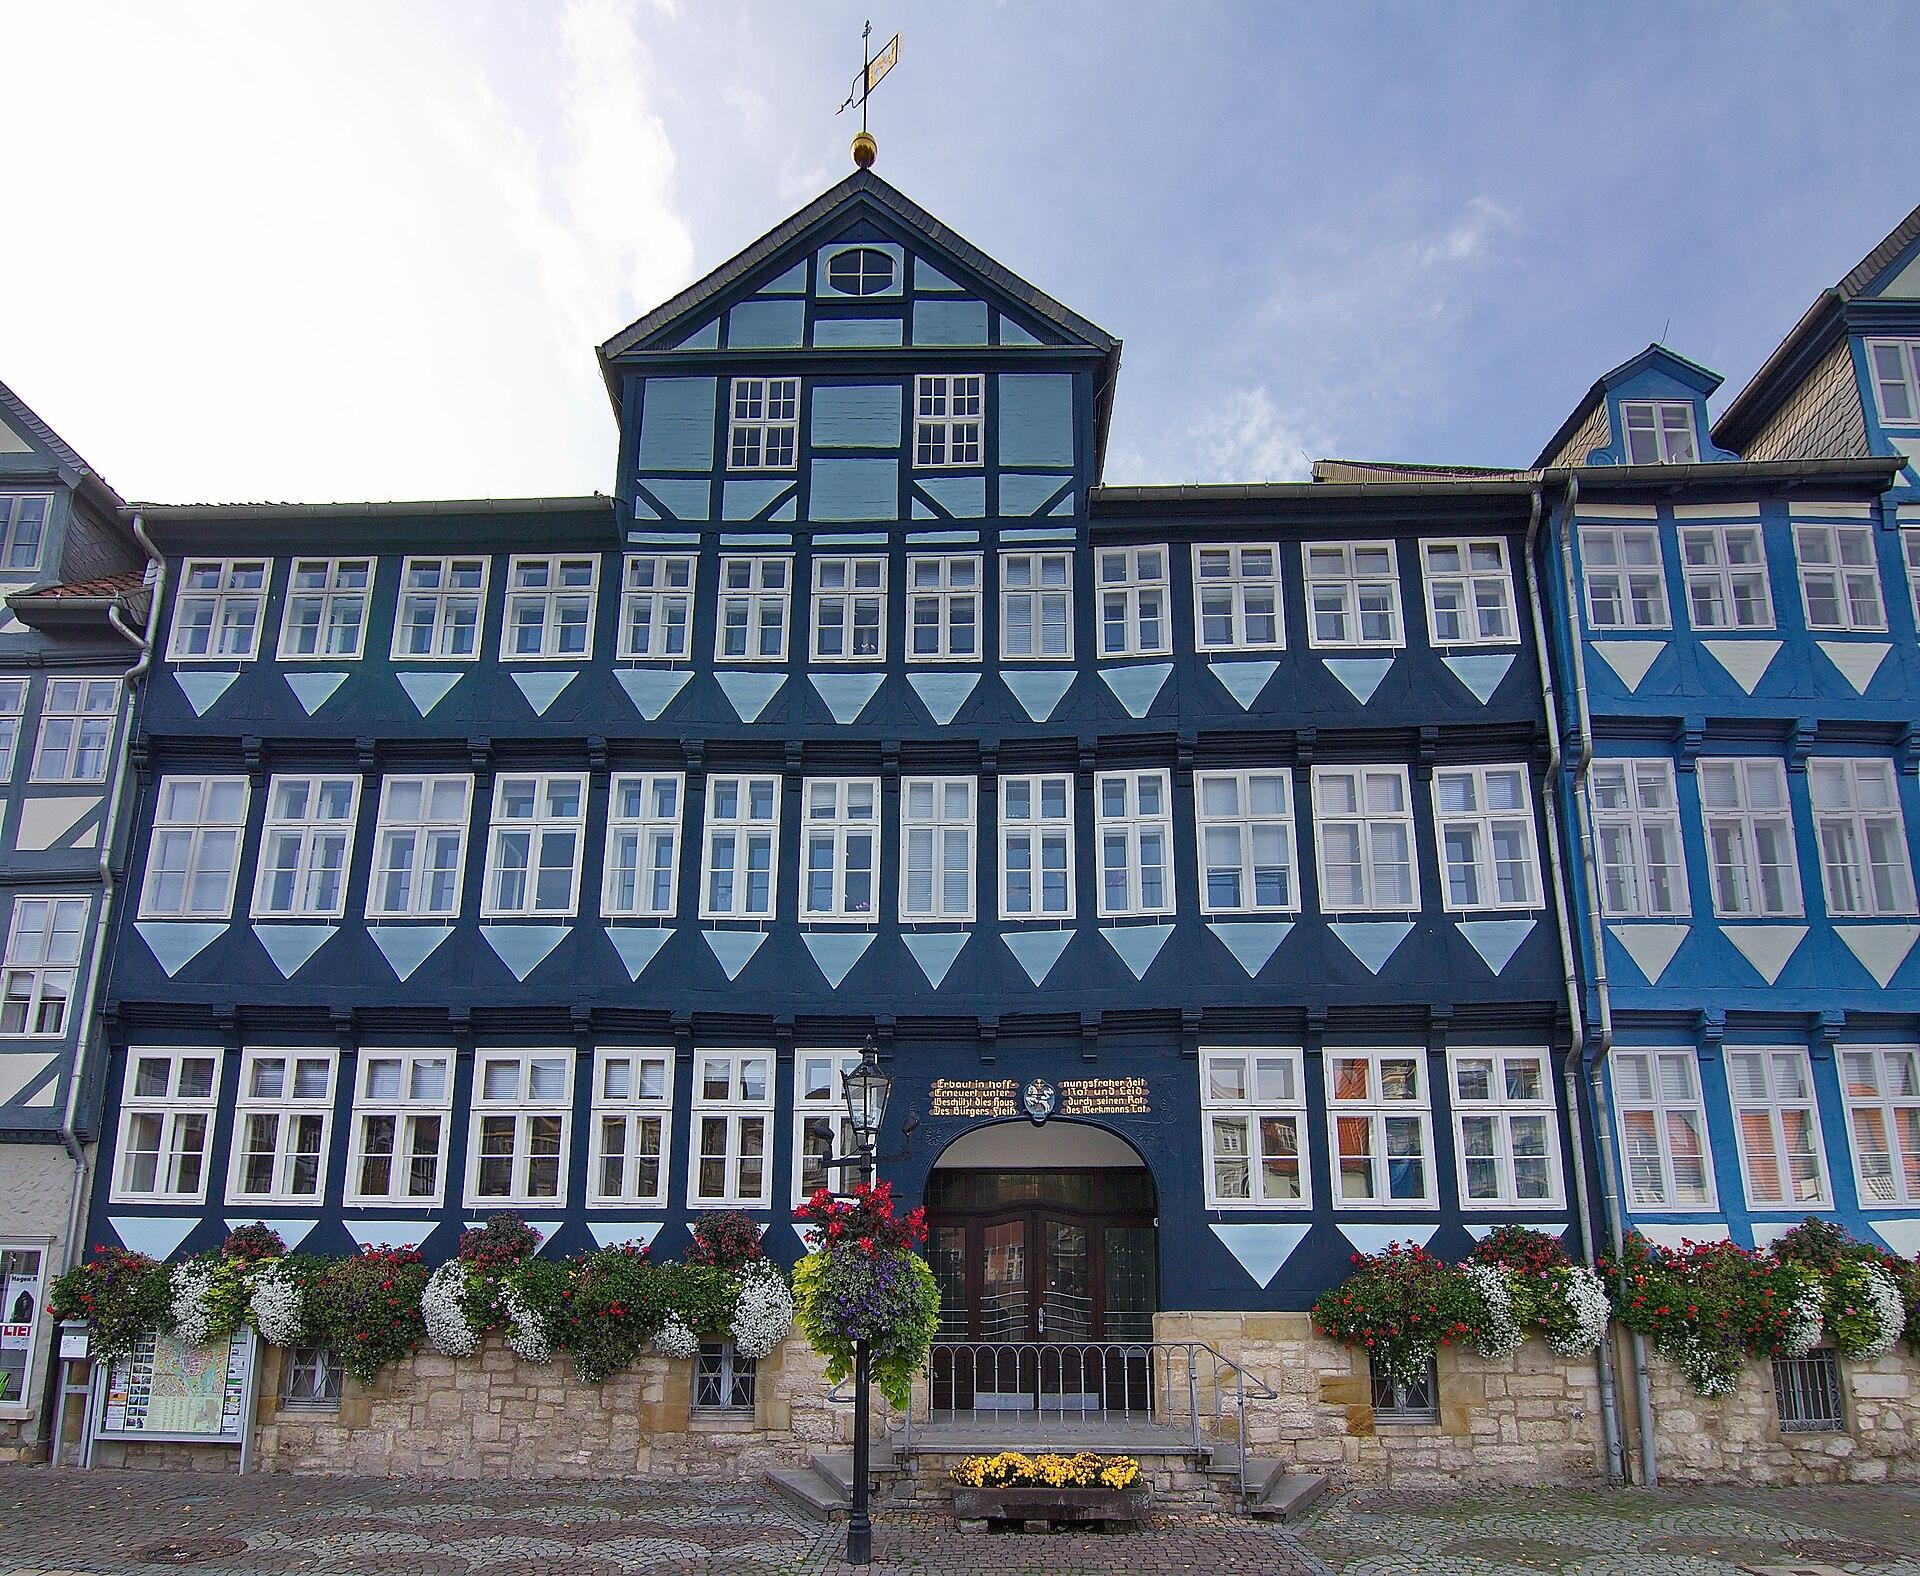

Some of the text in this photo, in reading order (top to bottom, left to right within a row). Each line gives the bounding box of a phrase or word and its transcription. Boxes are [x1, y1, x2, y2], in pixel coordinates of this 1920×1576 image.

[937, 1079, 971, 1089] Erbaut
[975, 1080, 985, 1089] in
[1126, 1077, 1145, 1088] Zeit
[934, 1089, 1010, 1097] Erneuert unter
[1094, 1087, 1115, 1096] und
[1120, 1086, 1142, 1095] Leid
[975, 1098, 991, 1106] dies
[993, 1097, 1015, 1108] Haus
[1068, 1095, 1144, 1106] durch seinen Rat
[933, 1106, 1016, 1117] Des Bürgers Fleiß
[1066, 1106, 1080, 1114] des
[1130, 1104, 1146, 1113] Tat
